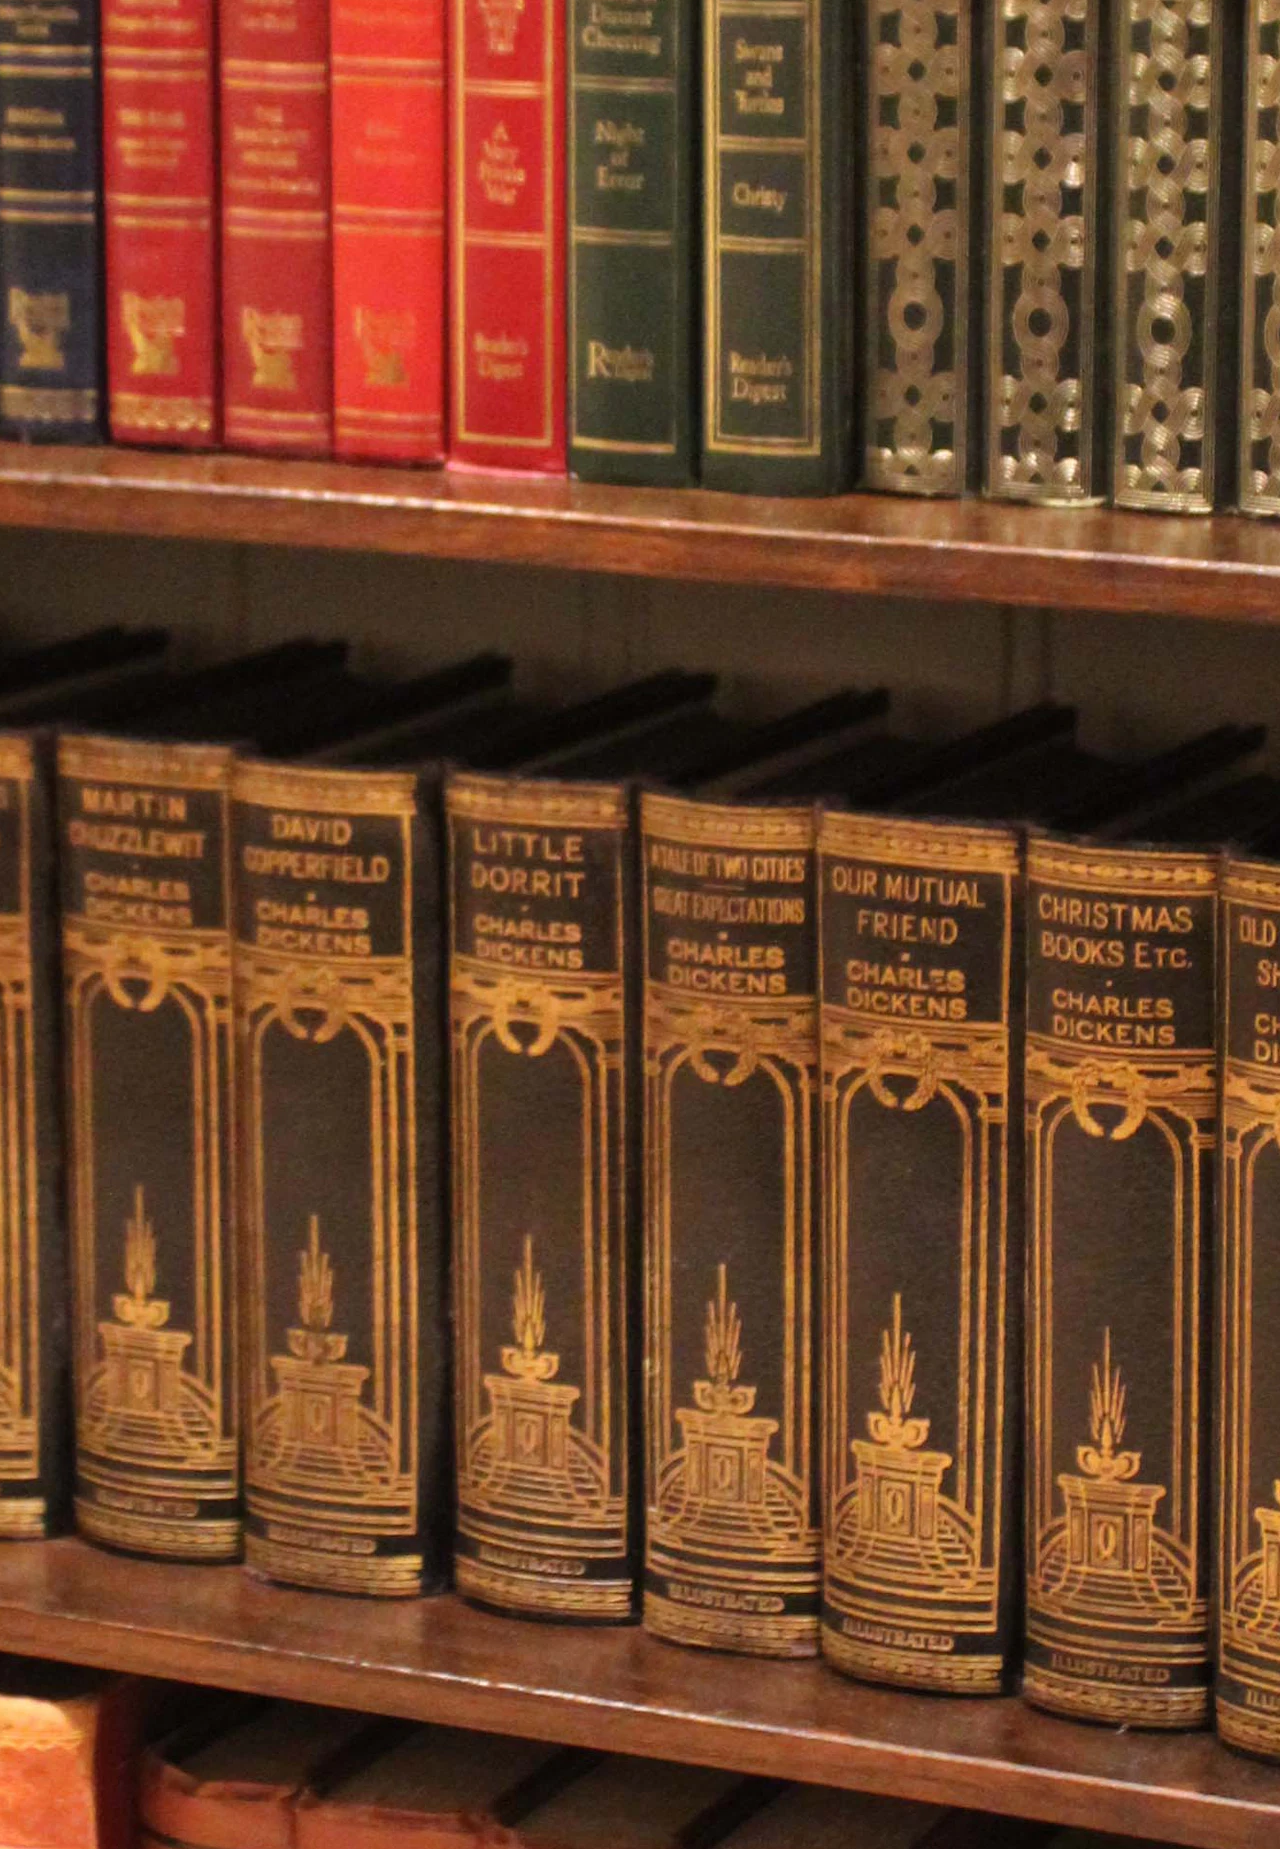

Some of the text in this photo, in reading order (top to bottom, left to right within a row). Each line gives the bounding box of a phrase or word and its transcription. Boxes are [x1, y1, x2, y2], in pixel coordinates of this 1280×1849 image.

[271, 813, 353, 846] DAVID
[472, 828, 585, 863] LITTLE
[470, 860, 586, 899] DORRIT
[752, 855, 806, 884] CITIES
[832, 865, 987, 909] OUR MUTUAL
[255, 899, 370, 930] CHARLES
[472, 912, 583, 944] CHARLES
[858, 909, 959, 946] FRIEND
[1038, 893, 1194, 934] CHRISTMAS
[255, 924, 372, 956] DICKENS
[1239, 915, 1277, 949] OLD
[475, 937, 584, 970] DICKENS
[667, 938, 786, 970] CHARLES
[1041, 930, 1126, 968] BOOKS
[667, 964, 788, 995] DICKENS
[846, 959, 966, 993] CHARLES
[846, 986, 968, 1021] DICKENS
[1052, 988, 1176, 1019] CHARLES
[1052, 1014, 1177, 1047] DICKENS
[841, 1616, 955, 1653] ILLUSTRATED
[1051, 1652, 1171, 1685] ILLUSTRATED
